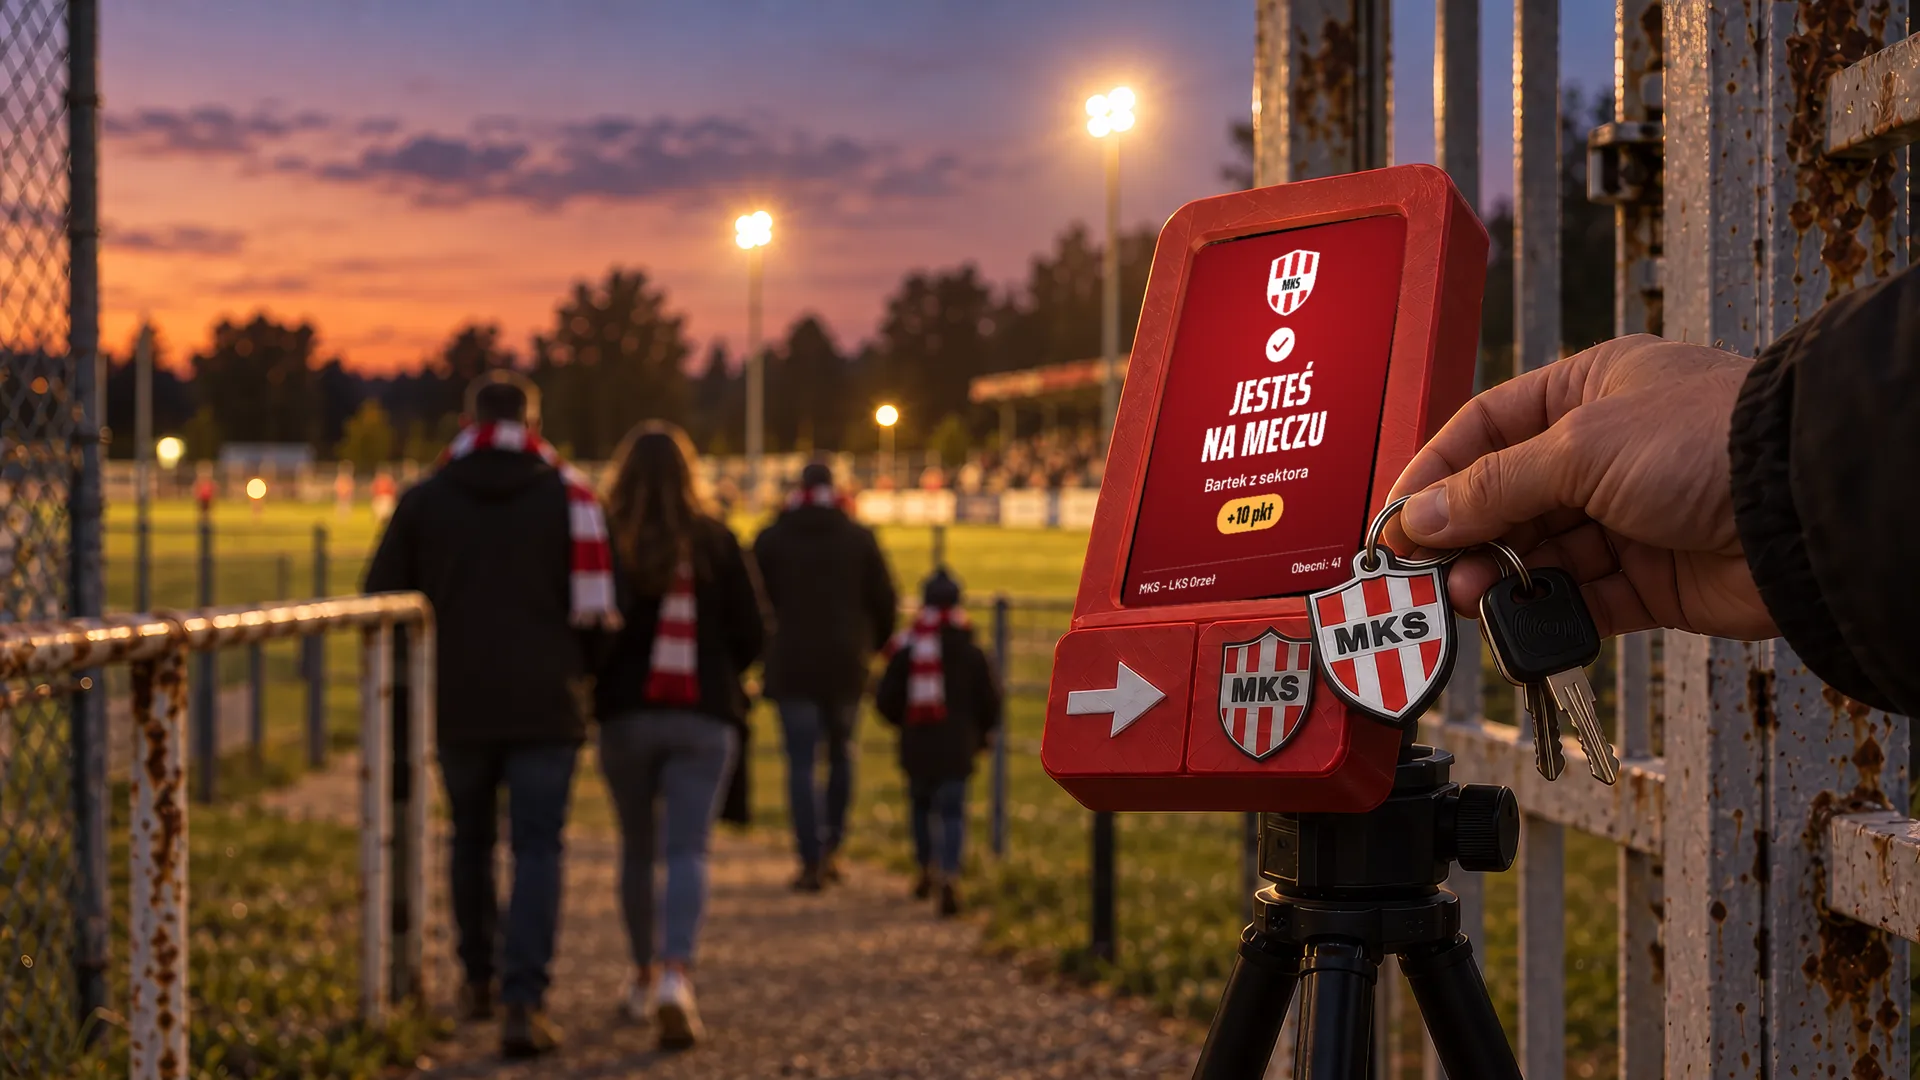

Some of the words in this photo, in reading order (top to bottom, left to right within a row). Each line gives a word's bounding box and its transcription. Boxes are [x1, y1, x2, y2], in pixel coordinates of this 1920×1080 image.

[1281, 277, 1301, 291] MKS
[1228, 361, 1314, 416] JESTEŚ
[1201, 424, 1236, 463] NA
[1241, 410, 1328, 457] MECZU
[1204, 473, 1247, 493] Bartek
[1249, 474, 1257, 486] z
[1259, 467, 1309, 485] sektora
[1227, 505, 1250, 525] +10
[1250, 502, 1274, 527] pkt
[1291, 558, 1329, 574] Obecni:
[1331, 557, 1342, 568] 41
[1139, 581, 1160, 595] MKS
[1168, 578, 1189, 591] LKS
[1189, 574, 1216, 587] Orzeł
[1333, 611, 1430, 656] MKS
[1231, 674, 1300, 703] MKS
